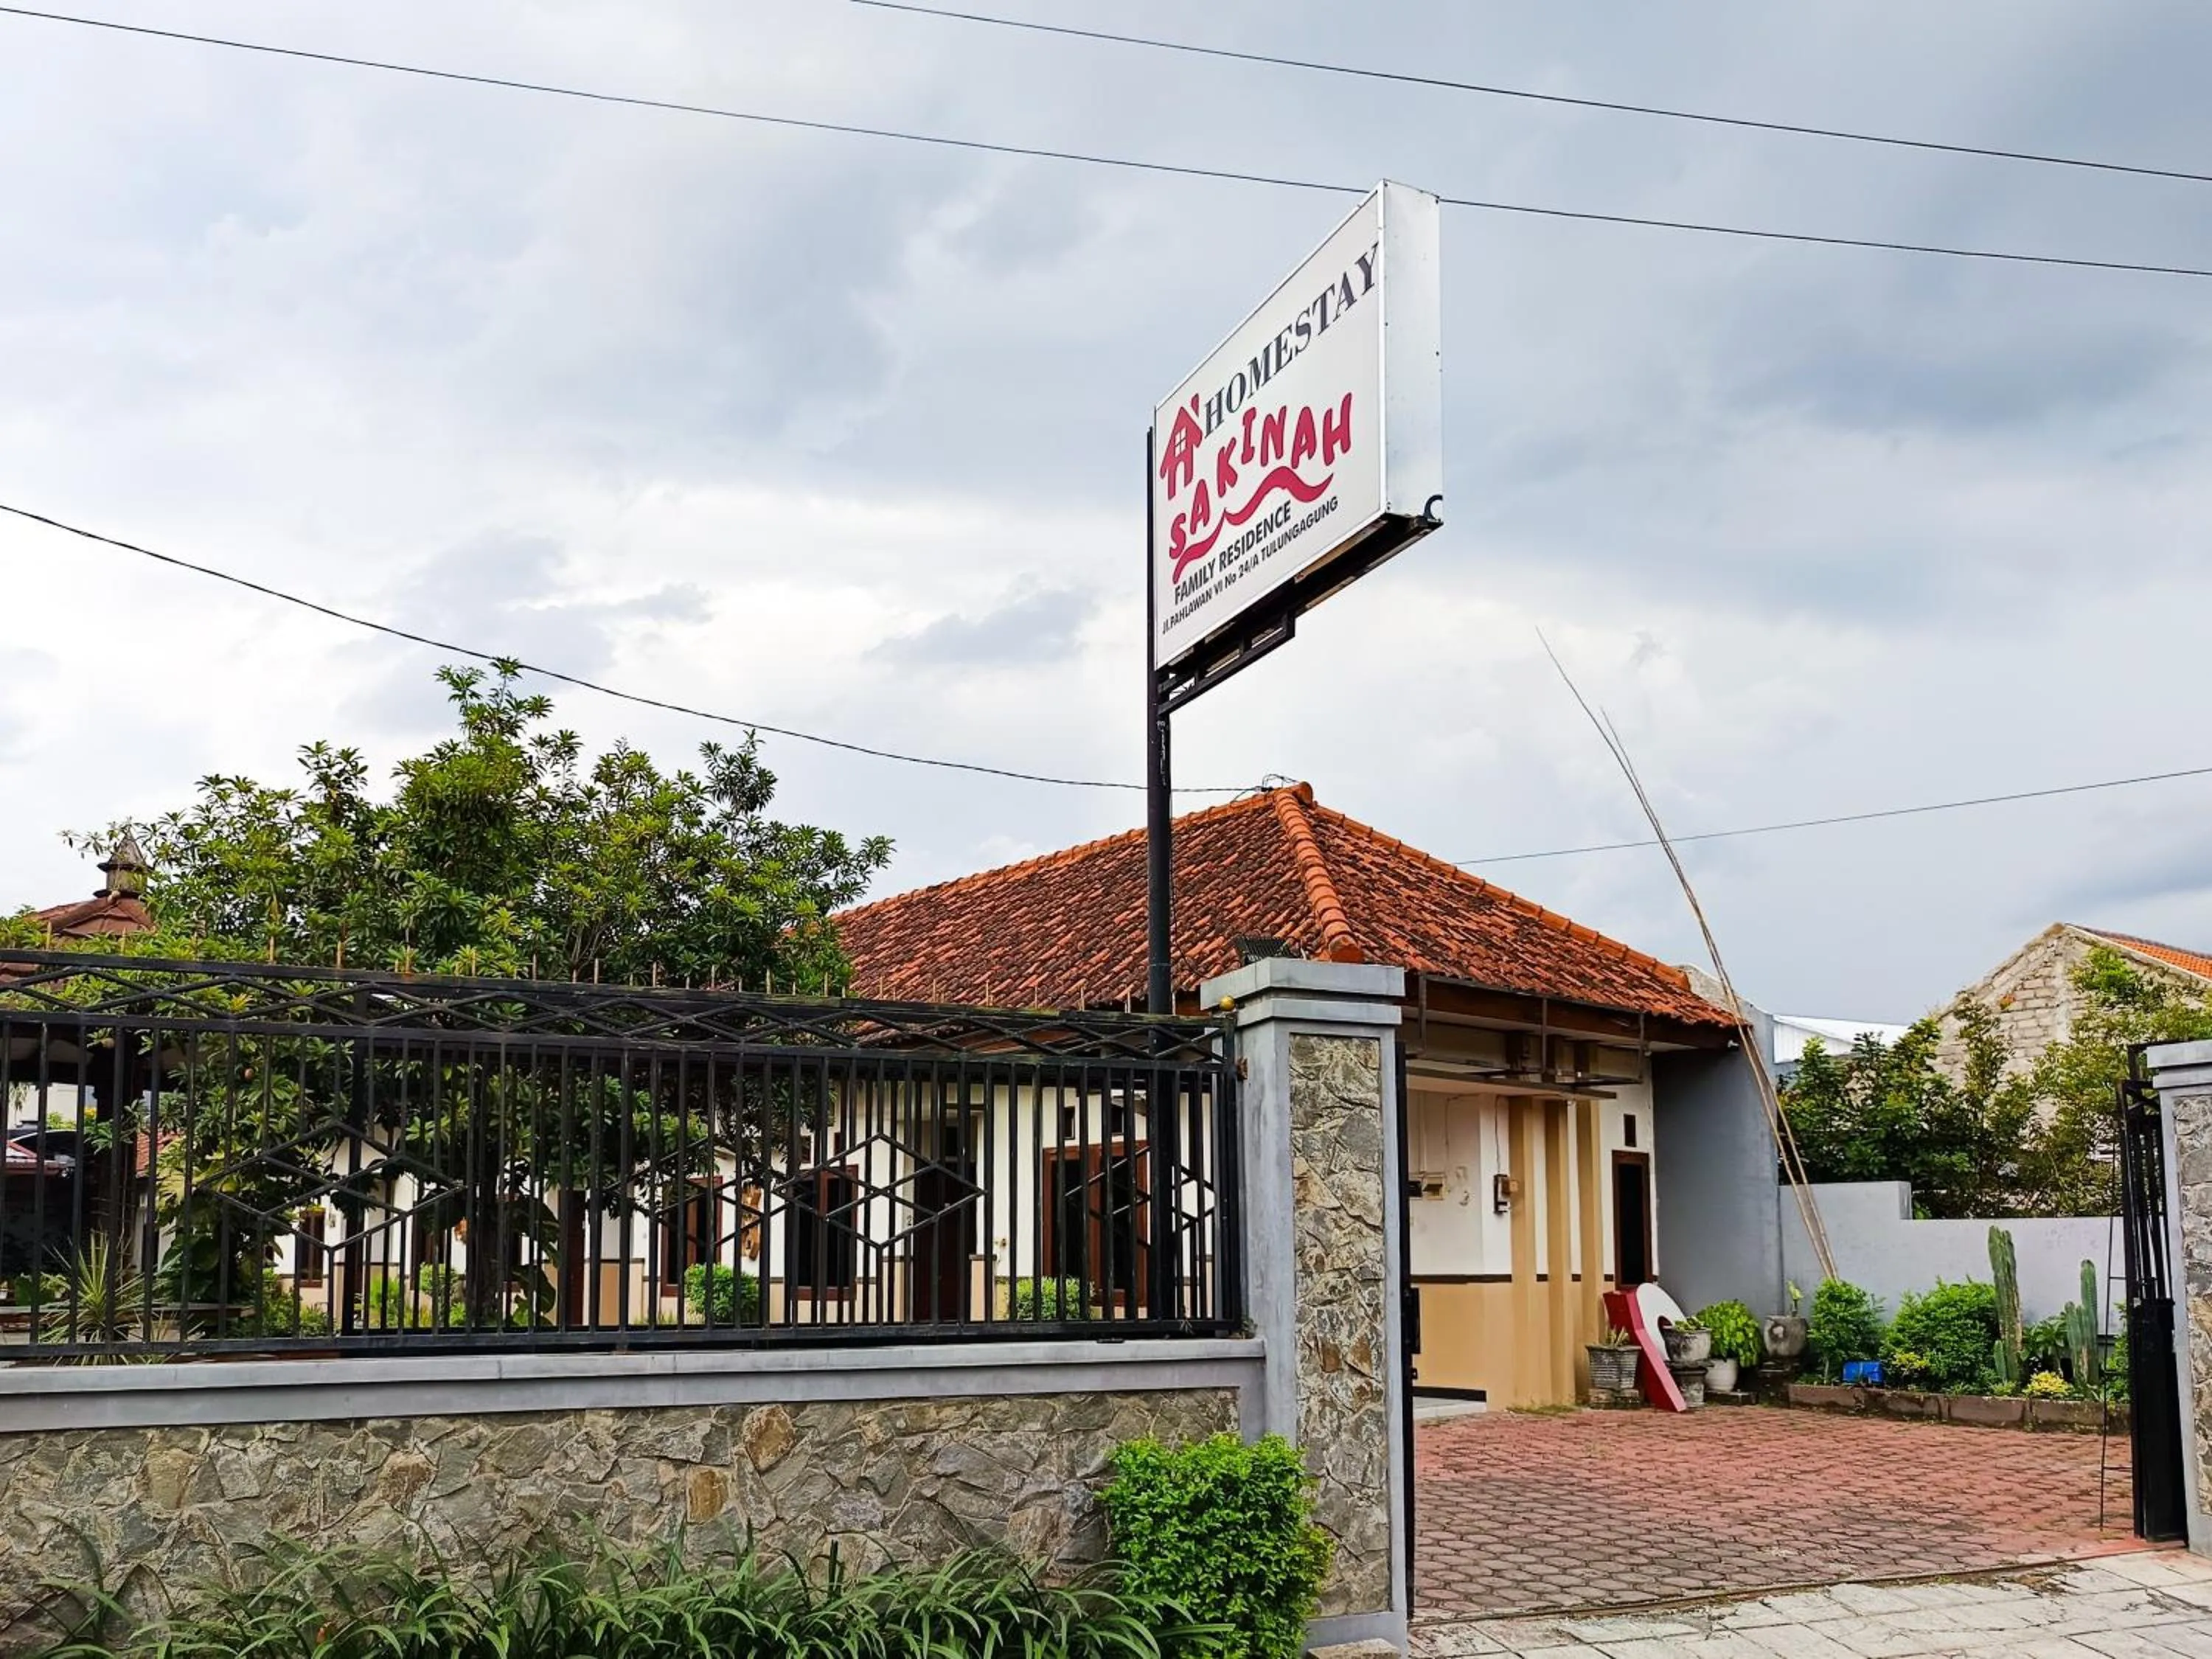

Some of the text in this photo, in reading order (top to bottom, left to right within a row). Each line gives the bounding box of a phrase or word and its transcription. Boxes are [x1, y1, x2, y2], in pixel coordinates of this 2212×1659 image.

[1205, 243, 1378, 439] HOMESTAY
[1169, 393, 1352, 559] SAKINAH
[1225, 572, 1237, 588] No
[1261, 496, 1338, 561] TULUNGAGUNG
[1175, 500, 1291, 605] FAMILY RESIDENCE
